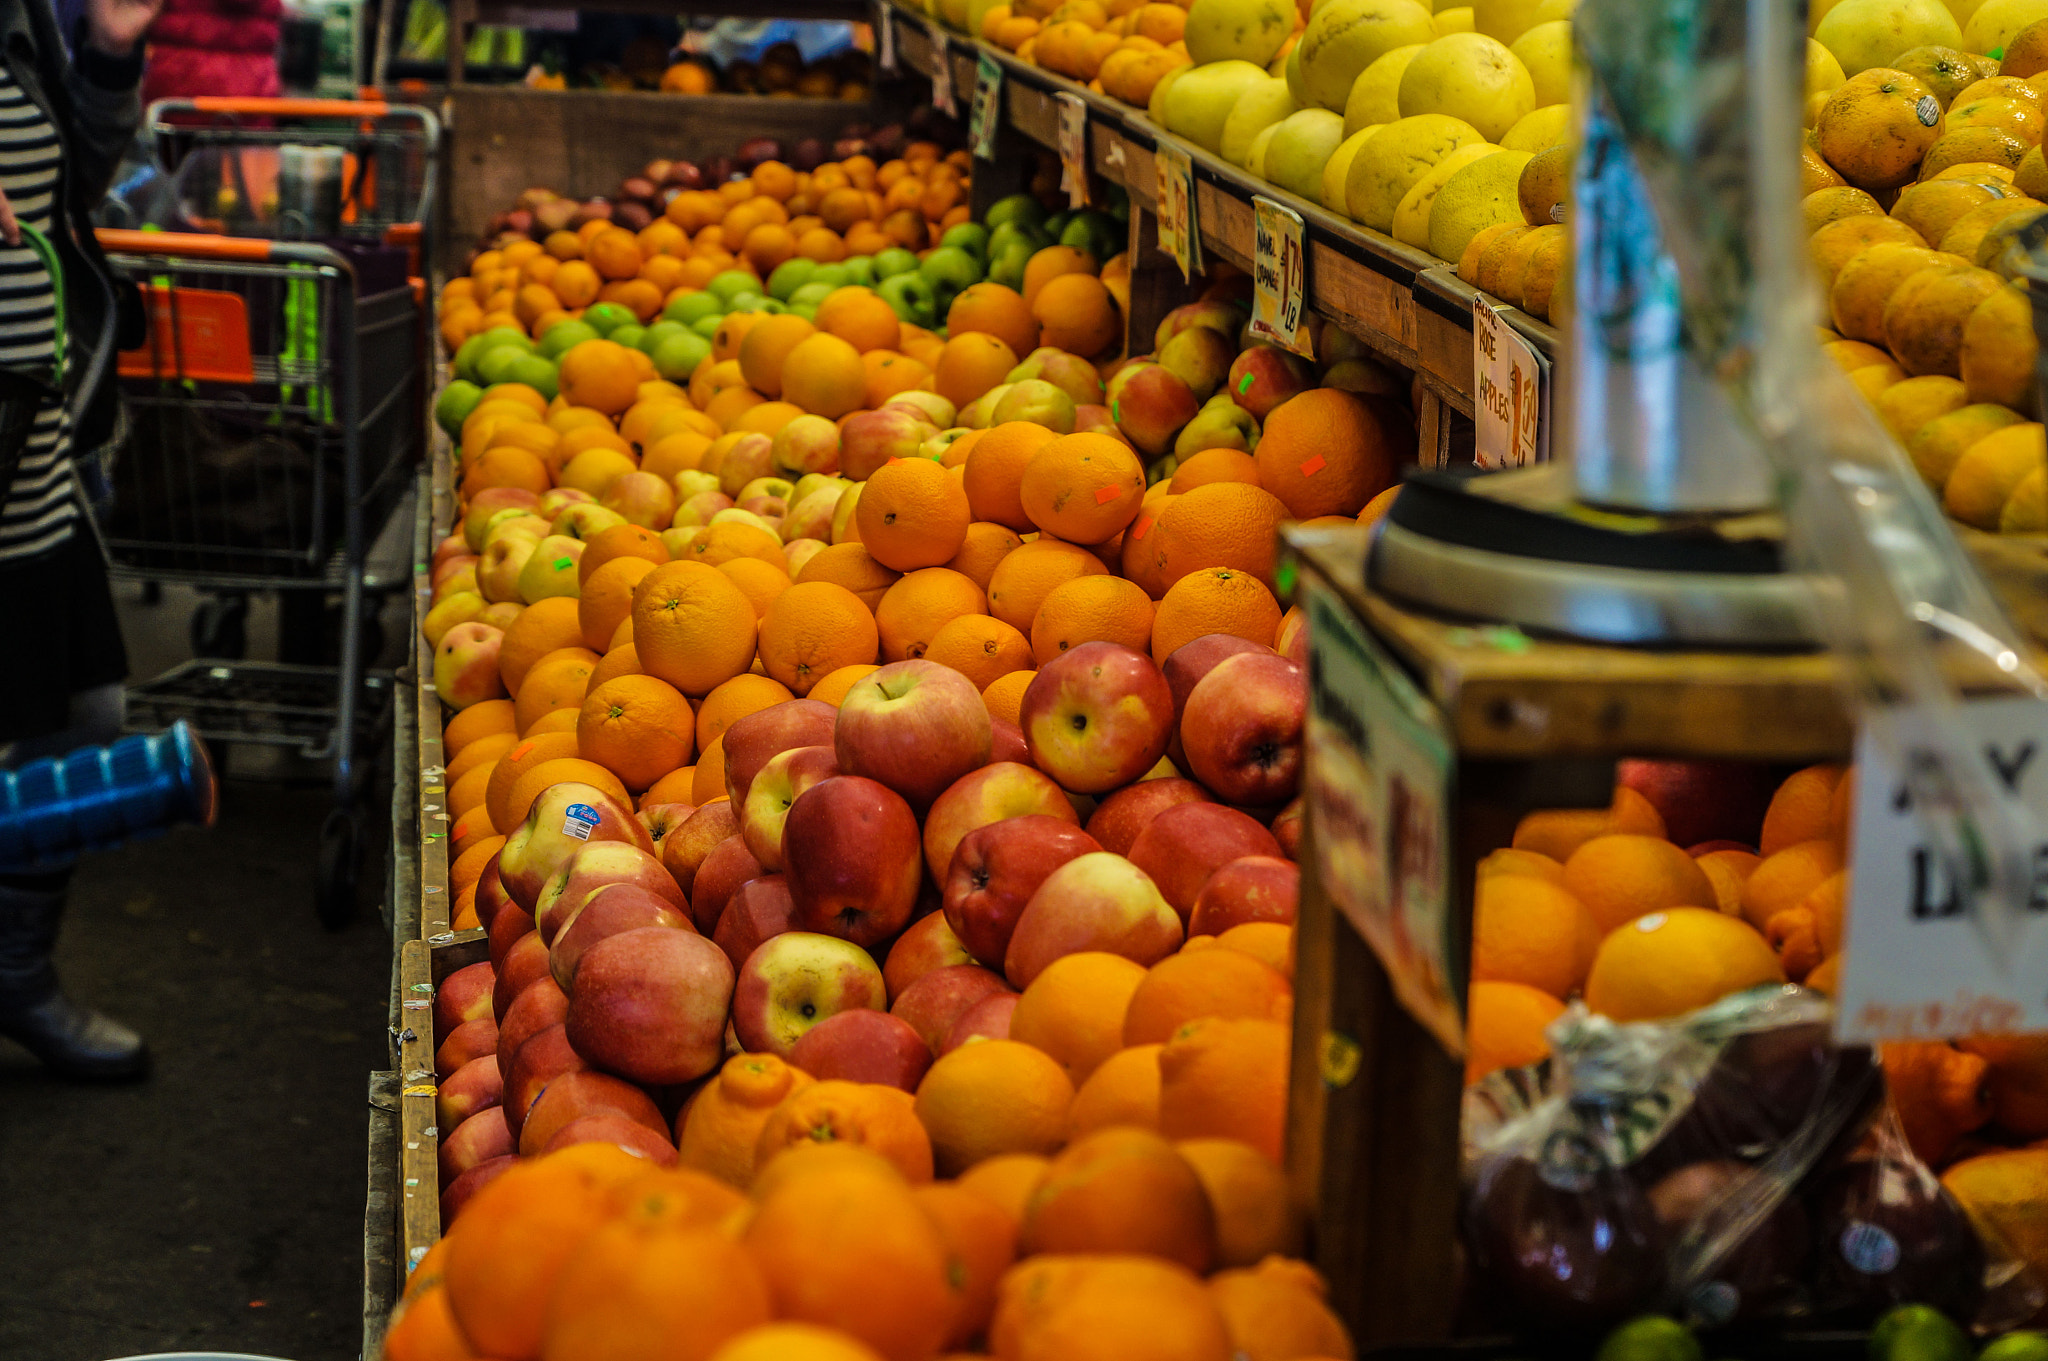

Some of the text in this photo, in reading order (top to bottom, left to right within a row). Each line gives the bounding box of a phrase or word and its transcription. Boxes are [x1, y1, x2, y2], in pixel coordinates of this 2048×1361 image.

[1285, 302, 1297, 333] LB
[1479, 318, 1496, 361] ROSE
[1480, 371, 1509, 423] APPLES
